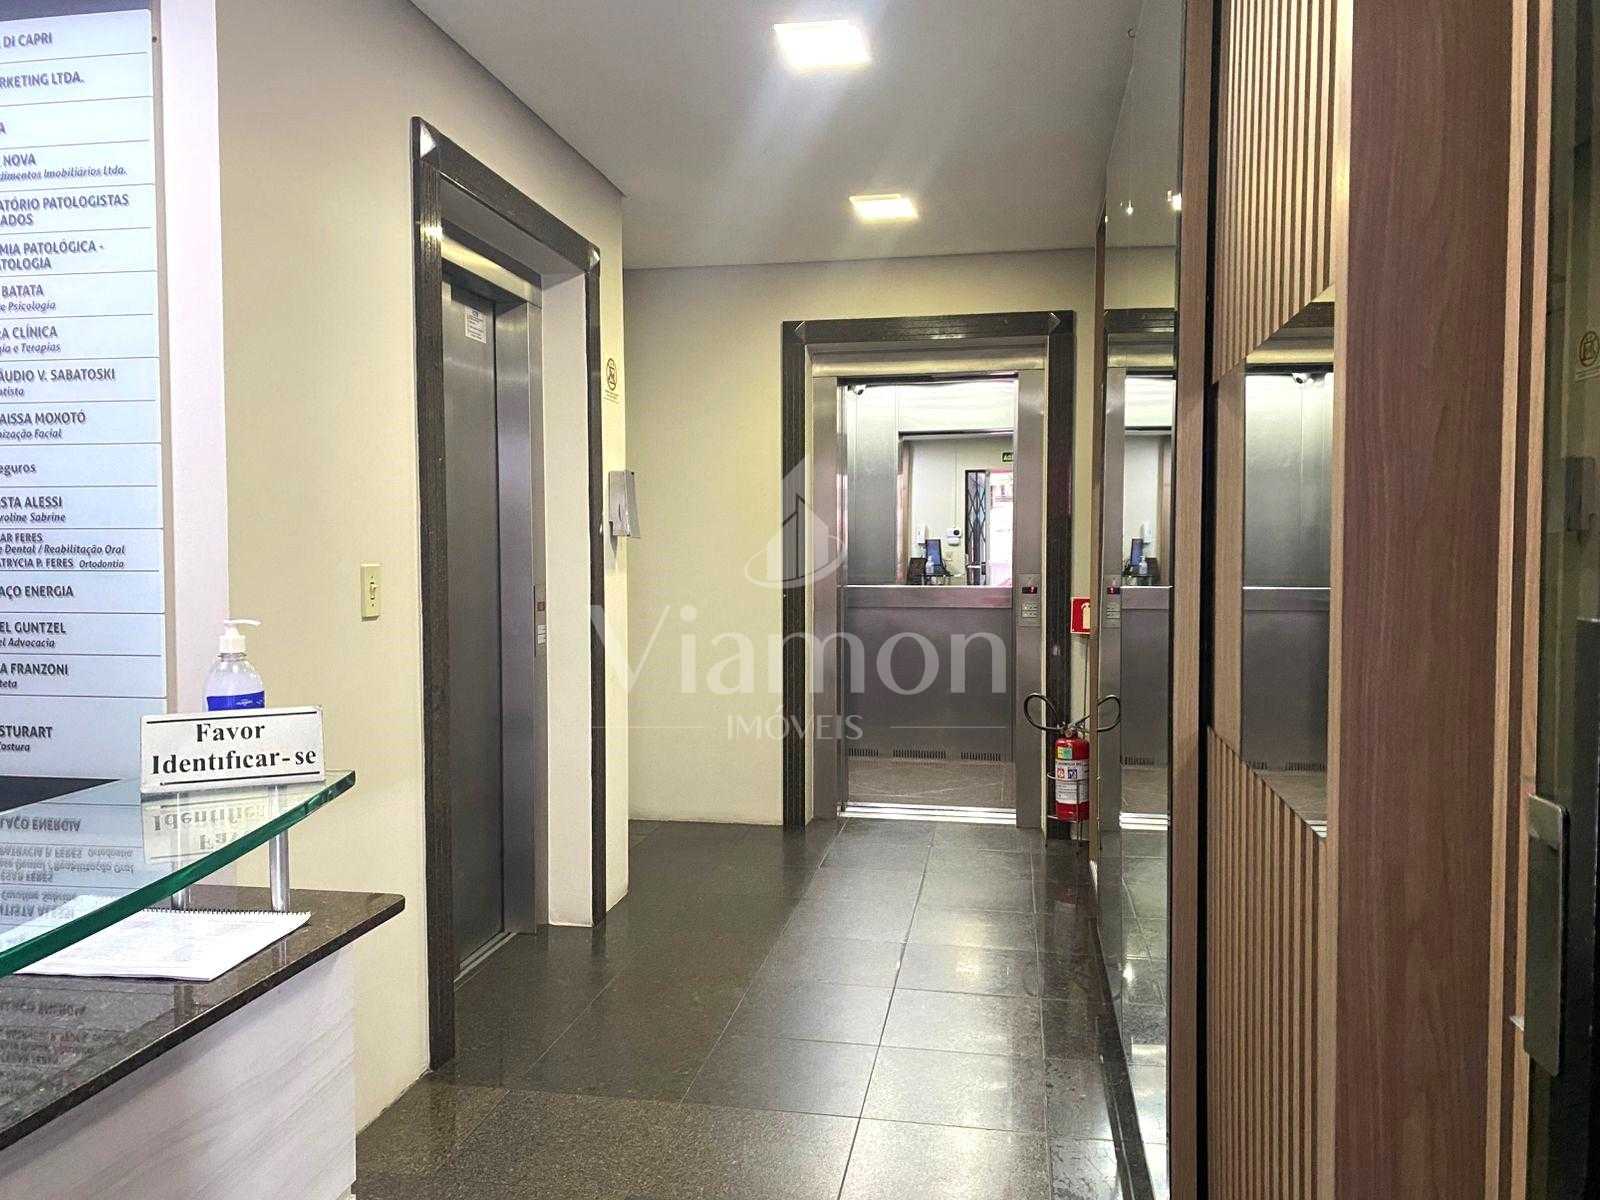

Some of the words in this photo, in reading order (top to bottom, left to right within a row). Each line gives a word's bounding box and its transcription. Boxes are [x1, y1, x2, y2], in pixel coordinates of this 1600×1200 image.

[3, 35, 16, 49] DI
[18, 32, 53, 47] CAPRI
[52, 71, 84, 86] LTDA.
[3, 153, 36, 167] NOVA
[44, 166, 101, 179] Imobiliários
[104, 164, 128, 177] Ltda.
[43, 193, 130, 209] PATOLOGISTAS
[1, 213, 34, 227] ADOS
[23, 239, 97, 255] PATOLÓGICA
[2, 284, 44, 298] BATATA
[8, 301, 56, 313] Psicologia
[12, 323, 58, 340] CLÍNICA
[13, 345, 19, 354] e
[21, 342, 61, 355] Terapias
[37, 369, 47, 382] V.
[50, 367, 116, 382] SABATOSKI
[35, 409, 86, 425] MOXOTÓ
[34, 427, 63, 440] Facial
[0, 496, 22, 510] STA
[25, 496, 62, 510] ALESSI
[30, 511, 66, 523] Sabrine
[0, 532, 13, 543] AR
[15, 532, 43, 543] FERES
[5, 544, 36, 555] Dental
[44, 543, 103, 556] Reabilitação
[105, 544, 126, 555] Oral
[36, 558, 43, 569] P.
[46, 558, 74, 569] FERES
[79, 559, 125, 569] Ortodontia
[25, 585, 74, 598] ENERGIA
[15, 621, 66, 635] GUNTZEL
[8, 637, 56, 649] Advocacia
[11, 663, 69, 676] FRANZONI
[0, 725, 53, 739] STURART
[196, 723, 265, 743] Favor
[152, 750, 317, 775] Identificar-se
